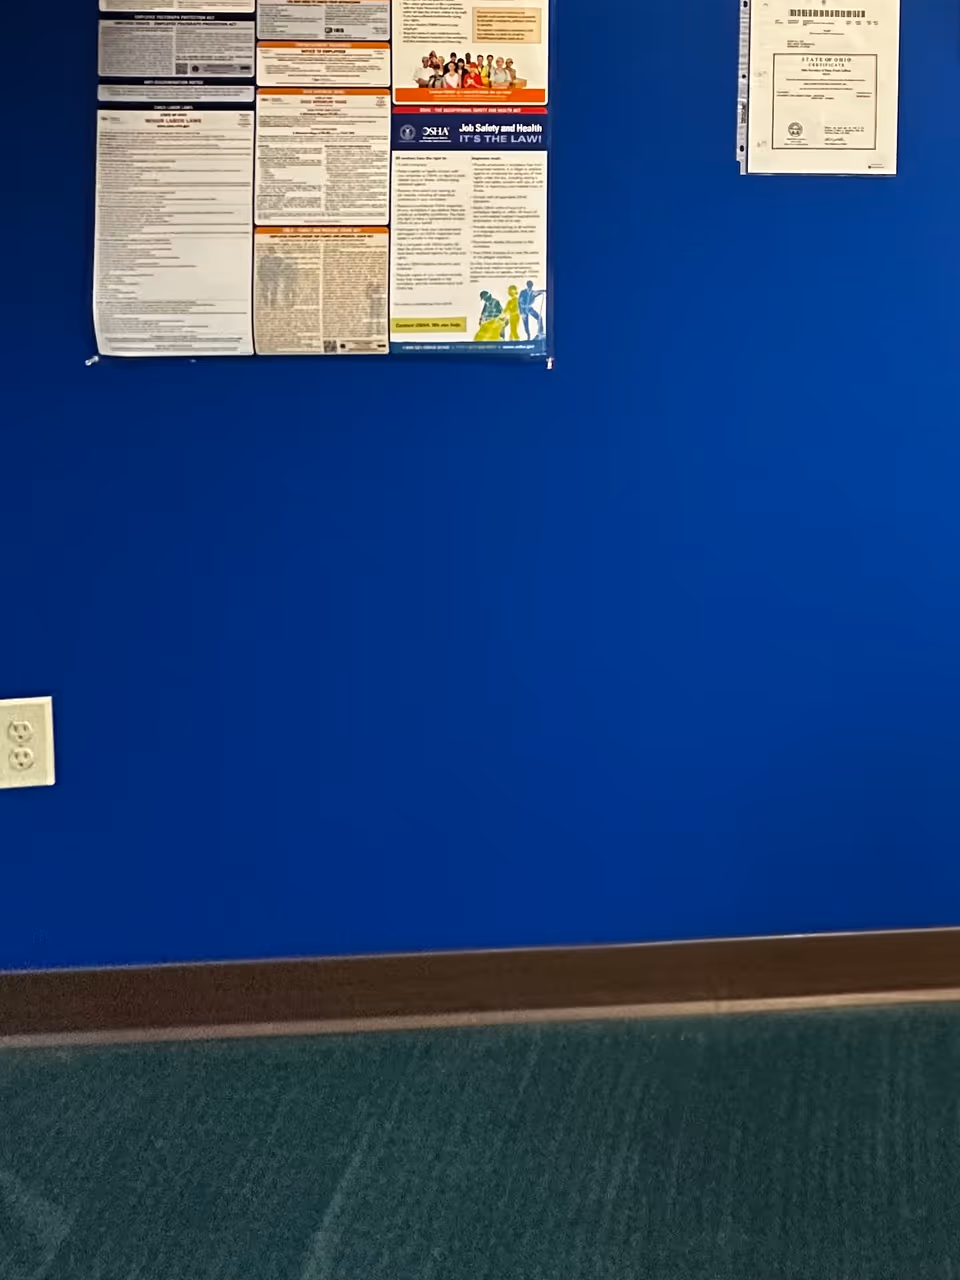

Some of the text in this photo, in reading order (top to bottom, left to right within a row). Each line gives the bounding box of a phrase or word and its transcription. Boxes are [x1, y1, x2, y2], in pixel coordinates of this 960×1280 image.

[422, 127, 449, 136] OSHA
[459, 124, 542, 134] Job Safety and Health
